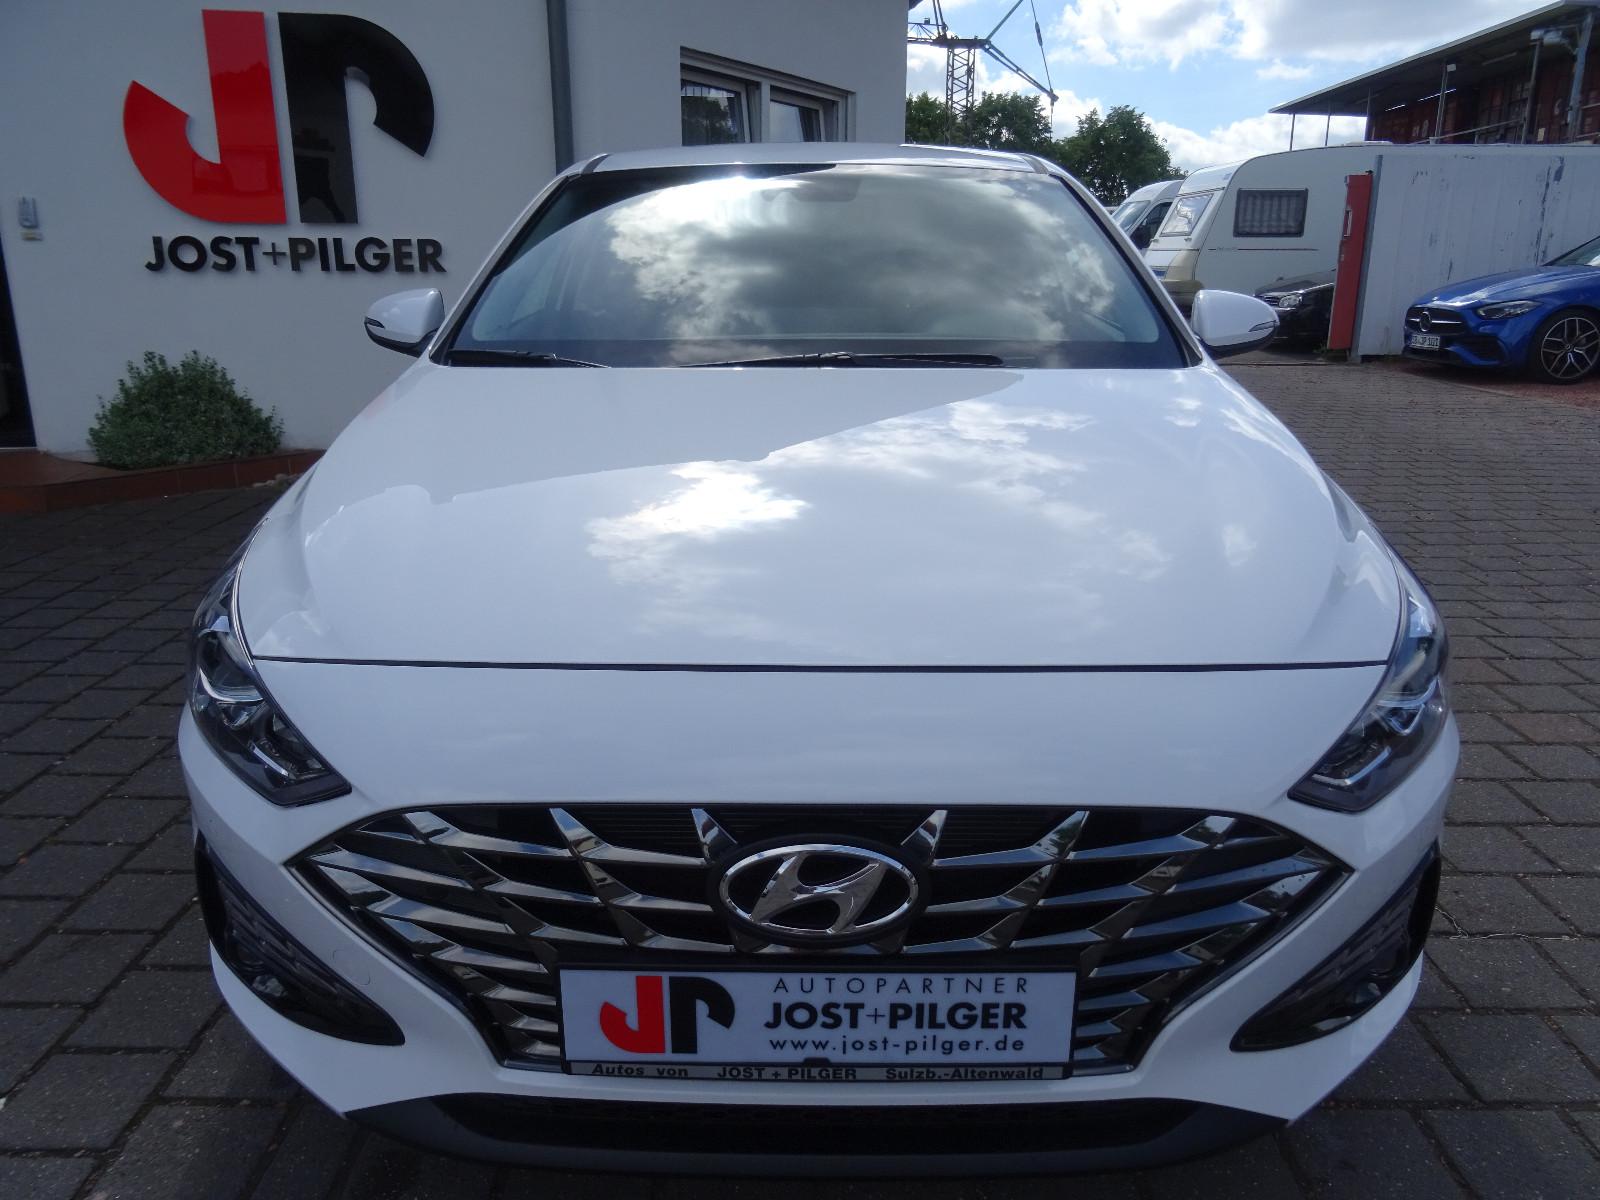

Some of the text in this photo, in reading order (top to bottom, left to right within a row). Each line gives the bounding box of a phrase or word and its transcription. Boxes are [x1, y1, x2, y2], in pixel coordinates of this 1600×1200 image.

[144, 235, 447, 273] JOST+PILGER
[773, 977, 1028, 994] AUTOPARTNER
[764, 1002, 1028, 1030] JOST+PILGER
[769, 1035, 1025, 1056] www.jost-pilger.de
[592, 1063, 645, 1076] Autos
[656, 1067, 688, 1077] von
[717, 1066, 766, 1079] JOST
[788, 1067, 857, 1080] PILGER
[886, 1066, 1044, 1080] Sulzb.-Altenwald
